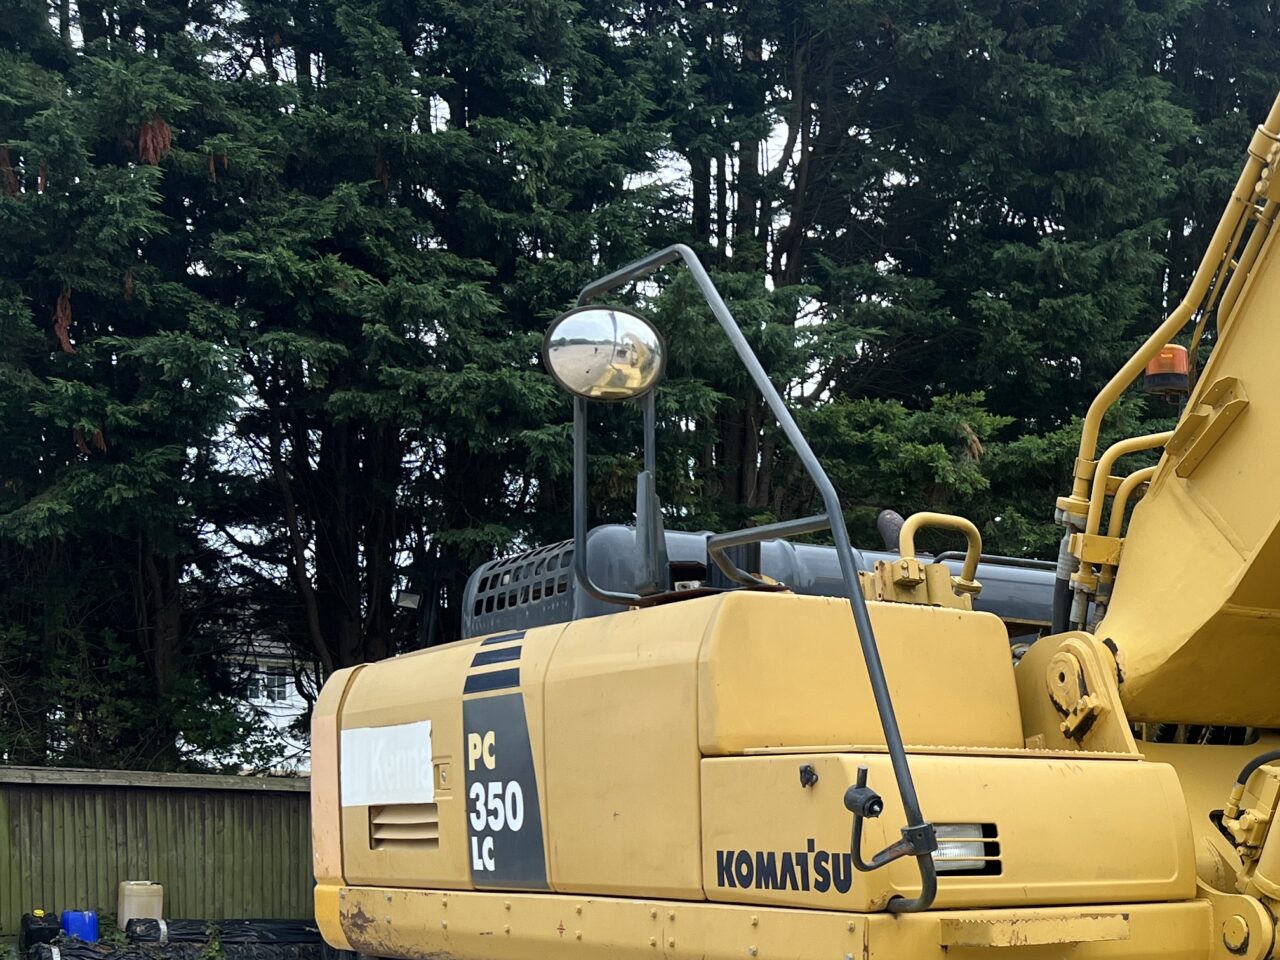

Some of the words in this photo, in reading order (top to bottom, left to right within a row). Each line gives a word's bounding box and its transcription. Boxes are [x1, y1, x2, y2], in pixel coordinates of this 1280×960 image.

[468, 730, 496, 771] PC
[469, 780, 524, 832] 350
[471, 836, 496, 872] LC
[716, 838, 853, 894] KOMATSU
